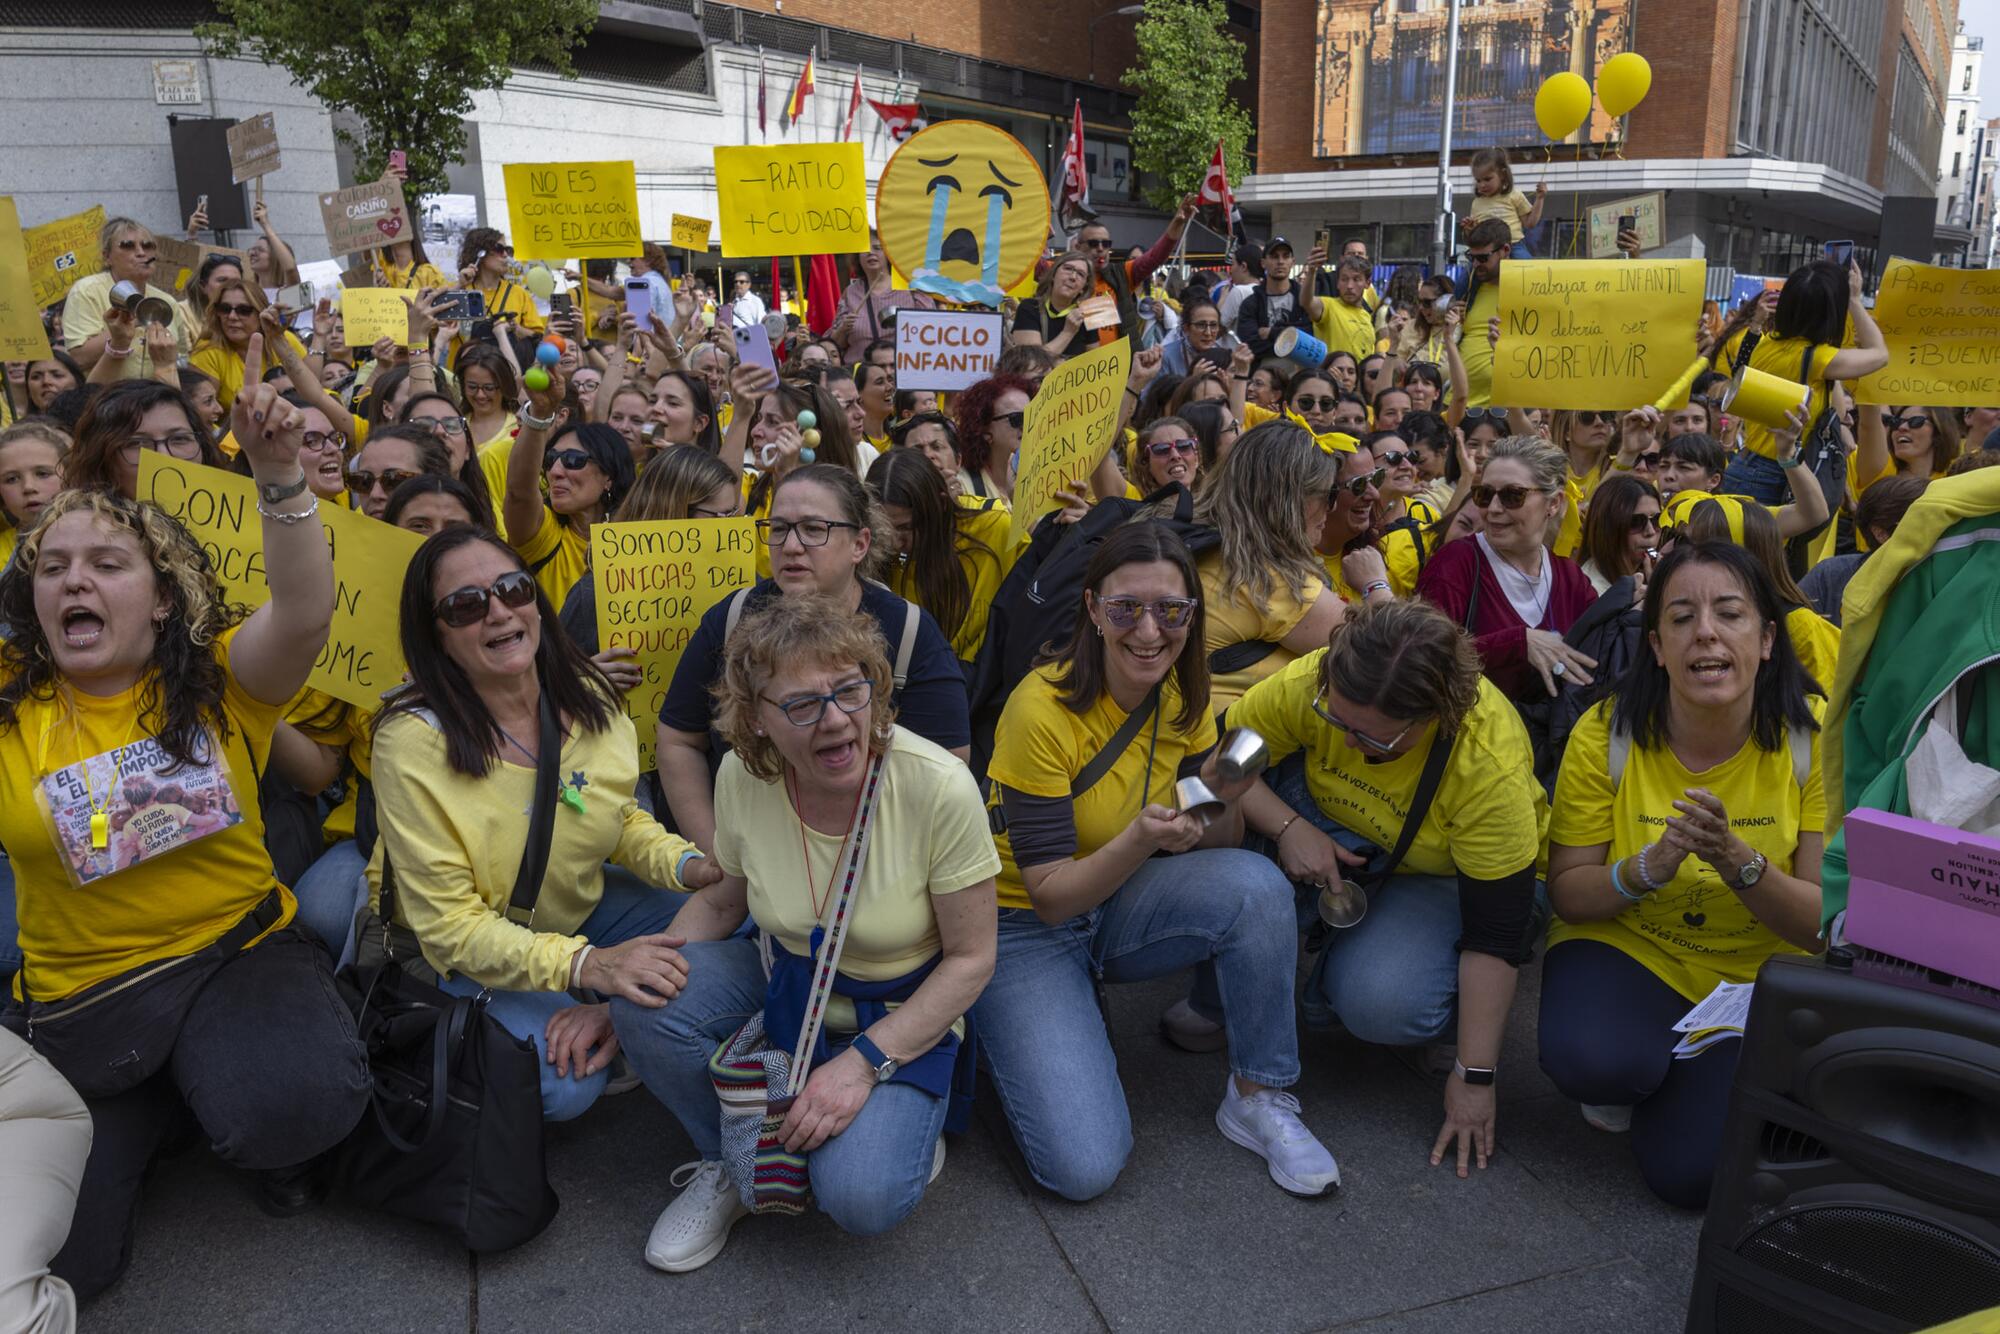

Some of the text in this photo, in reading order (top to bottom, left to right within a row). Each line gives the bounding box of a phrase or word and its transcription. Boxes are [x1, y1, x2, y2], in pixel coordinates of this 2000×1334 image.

[531, 170, 597, 193] NO ES
[346, 197, 388, 218] CARIÑO
[534, 217, 638, 242] ES EDUCACIÓN
[677, 231, 694, 243] 0-3
[1512, 264, 1688, 305] Trabajar en INFANTIL
[1509, 307, 1539, 336] NO
[1620, 319, 1649, 335] ser
[919, 324, 990, 347] CICLO
[1509, 340, 1649, 380] SOBREVIVIR
[152, 467, 244, 533] CON
[601, 528, 754, 559] SOMOS LAS
[605, 562, 749, 595] ÚNICAS DEL
[608, 596, 697, 625] SECTOR
[56, 769, 76, 788] EL
[185, 776, 213, 789] FUTURO
[1350, 777, 1368, 792] VOZ
[1367, 786, 1380, 798] DE
[69, 783, 89, 800] EL
[131, 808, 165, 829] YO CUIDO
[1731, 816, 1775, 828] INFANCIA
